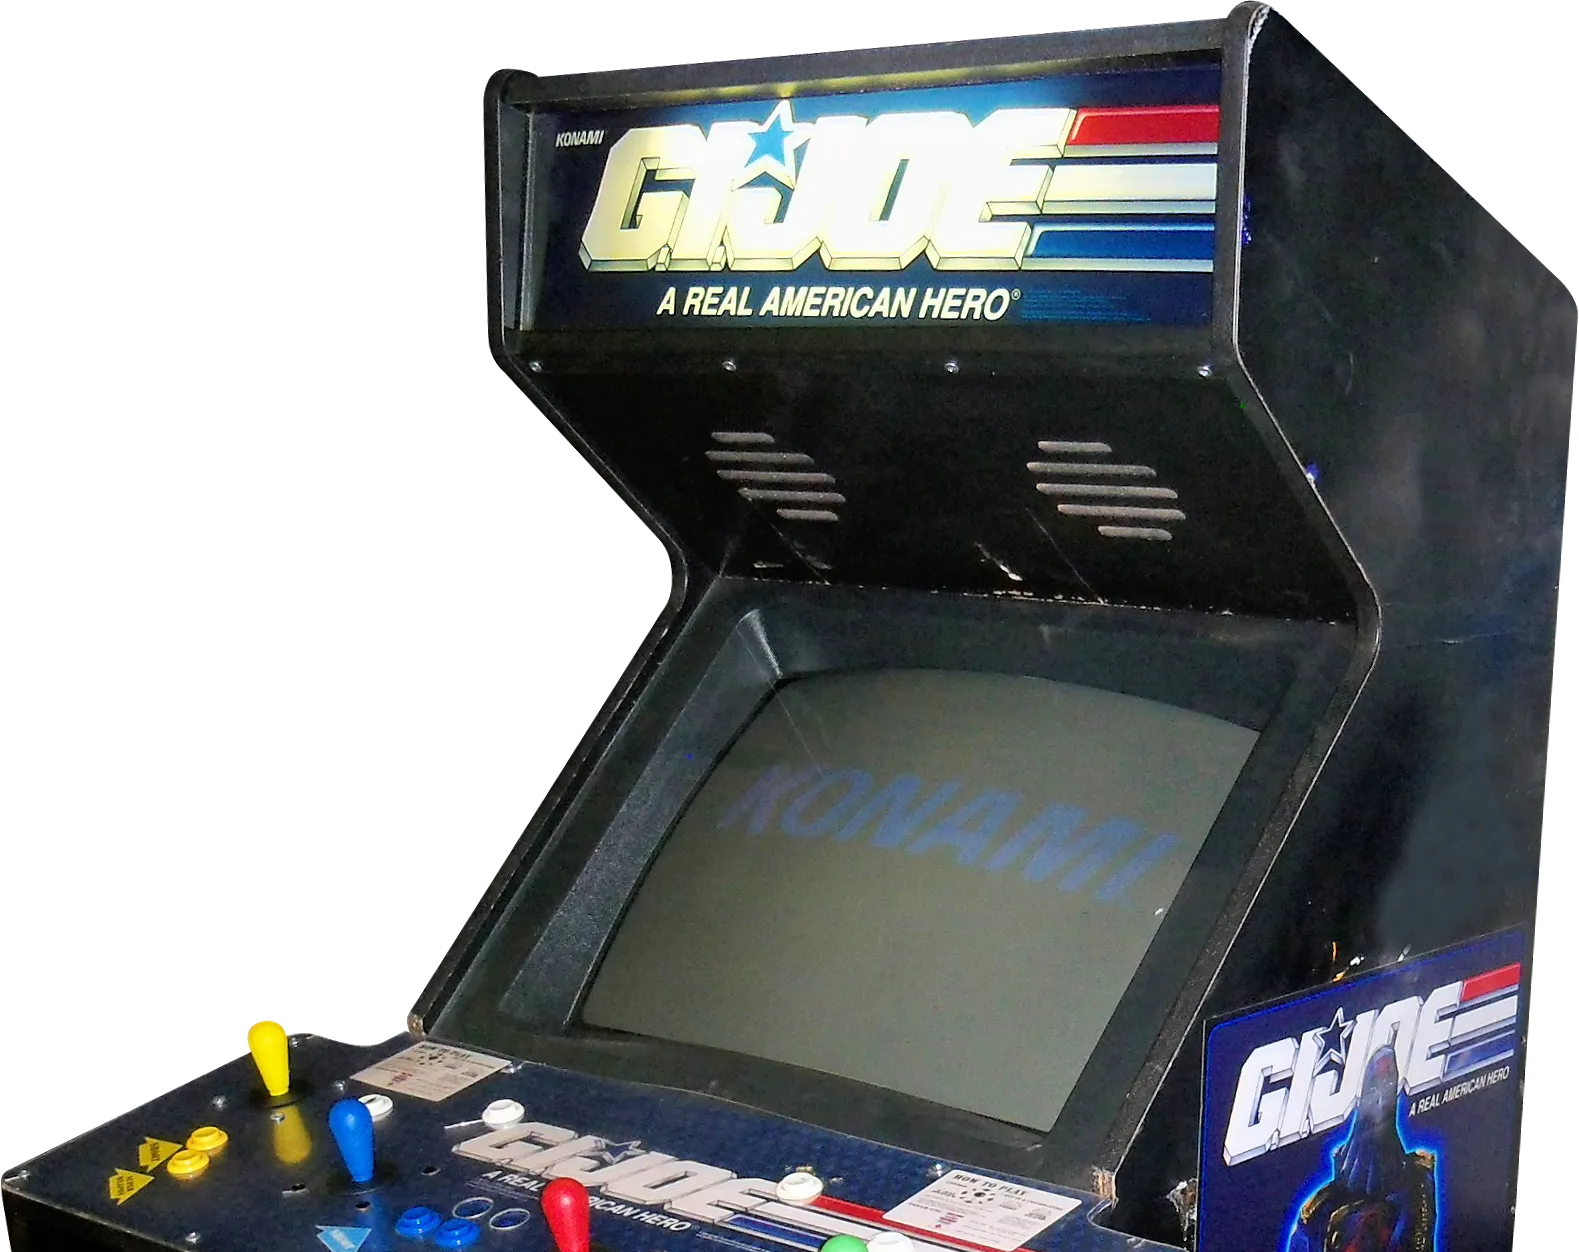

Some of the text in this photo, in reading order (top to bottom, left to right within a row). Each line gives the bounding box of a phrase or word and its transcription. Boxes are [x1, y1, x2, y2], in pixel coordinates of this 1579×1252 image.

[555, 129, 605, 147] KONAMI
[656, 286, 677, 316] A
[682, 286, 754, 317] REAL
[759, 286, 918, 319] AMERICAN
[716, 762, 1183, 902] KONAMI
[1408, 1065, 1510, 1118] A REAL AMERICAN HERO
[482, 1170, 503, 1180] A
[500, 1172, 546, 1192] REAL
[632, 1211, 692, 1232] HERO
[953, 1173, 1028, 1197] HOW TO PLAY
